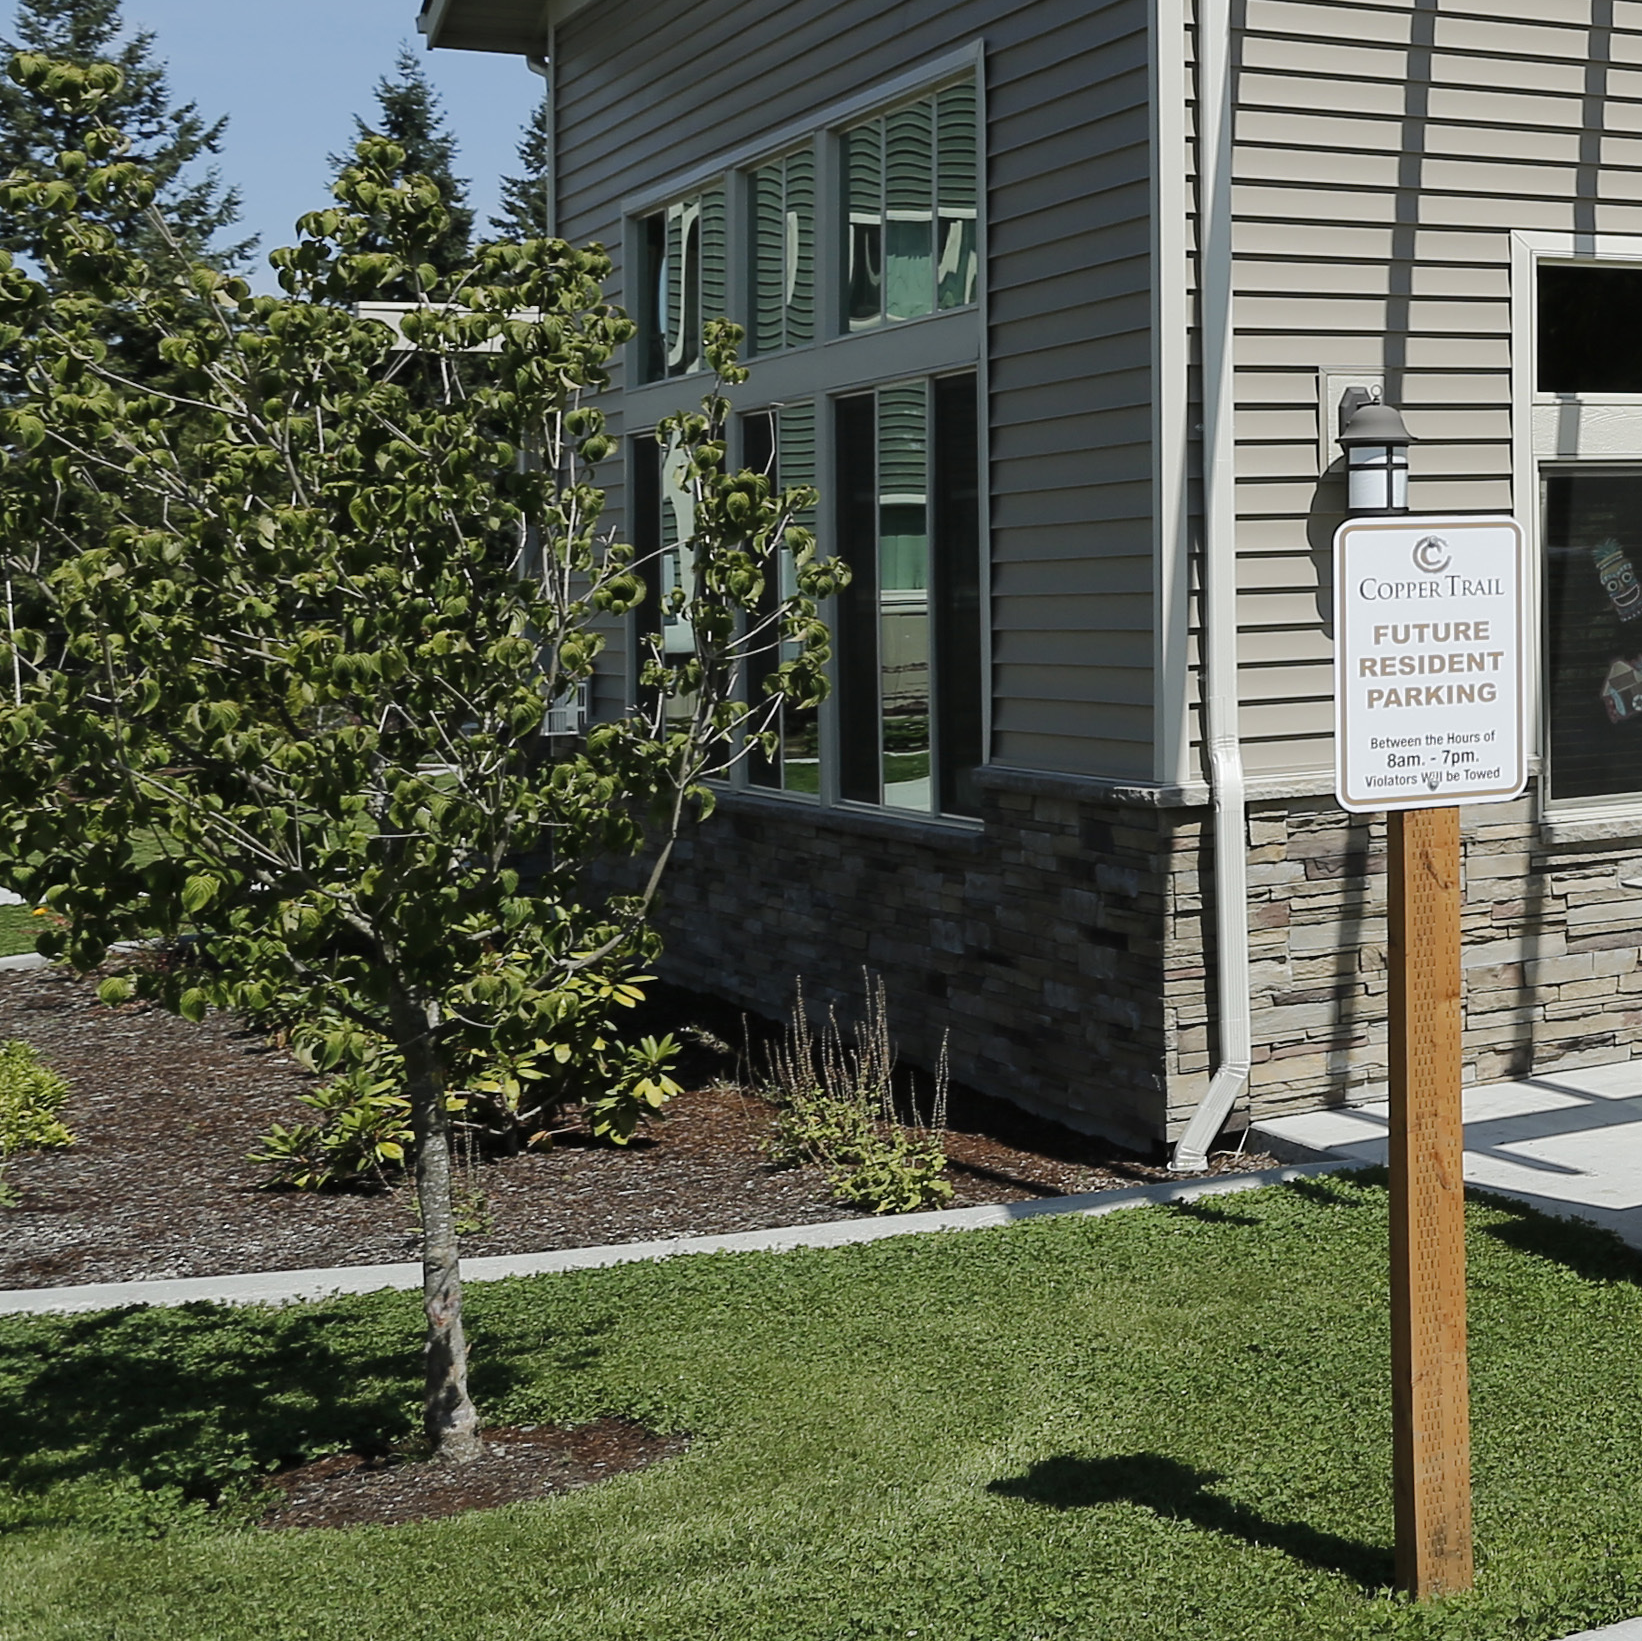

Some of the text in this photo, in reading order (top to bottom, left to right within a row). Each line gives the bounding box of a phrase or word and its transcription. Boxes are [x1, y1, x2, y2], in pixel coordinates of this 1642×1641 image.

[1373, 621, 1490, 645] FUTURE
[1359, 651, 1504, 678] RESIDENT
[1367, 683, 1497, 709] PARKING
[1370, 730, 1496, 750] Between the Hours of
[1386, 753, 1426, 769] 8am.
[1441, 749, 1480, 767] 7pm.
[1365, 774, 1418, 788] Violators
[1446, 769, 1461, 782] be
[1464, 767, 1501, 780] Towed
